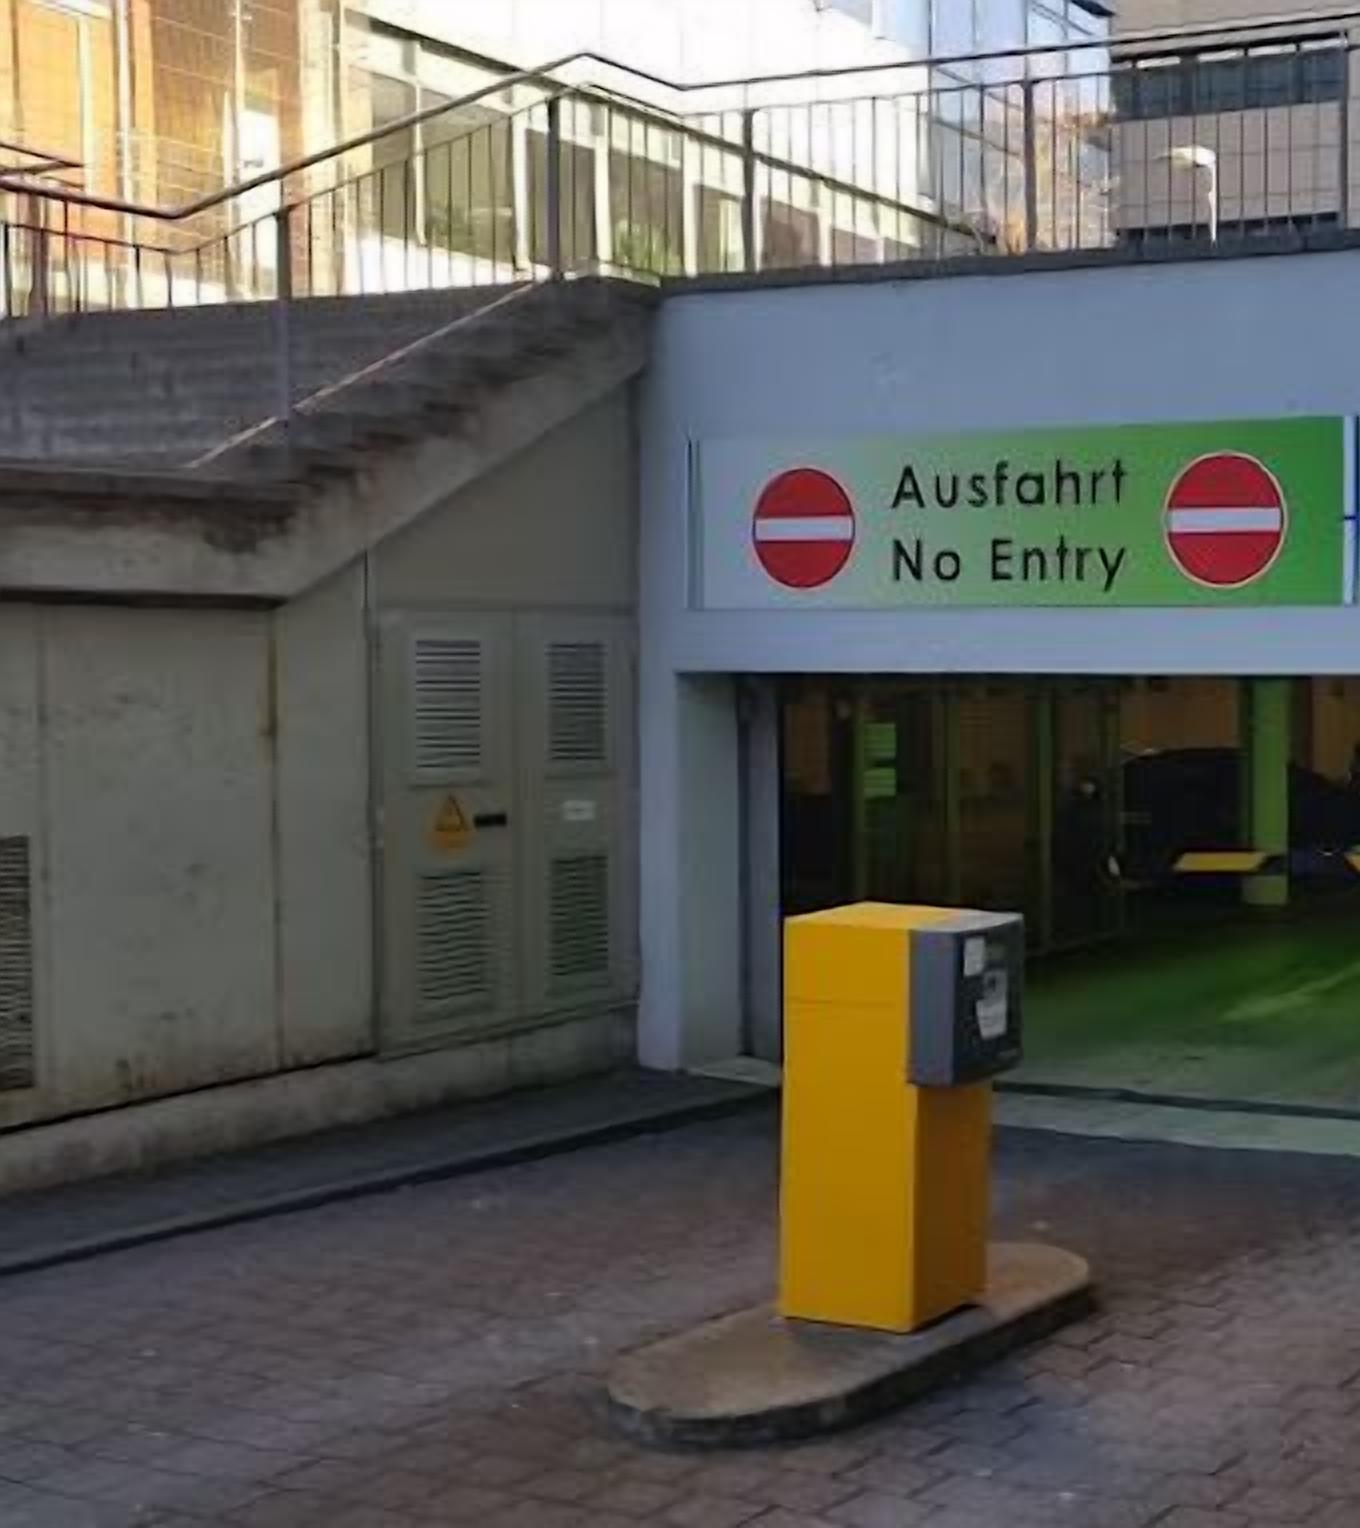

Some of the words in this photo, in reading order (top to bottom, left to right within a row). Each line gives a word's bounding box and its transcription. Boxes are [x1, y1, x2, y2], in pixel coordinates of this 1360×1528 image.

[892, 459, 1127, 508] Ausfahrt
[894, 537, 961, 581] No
[991, 534, 1126, 592] Entry
